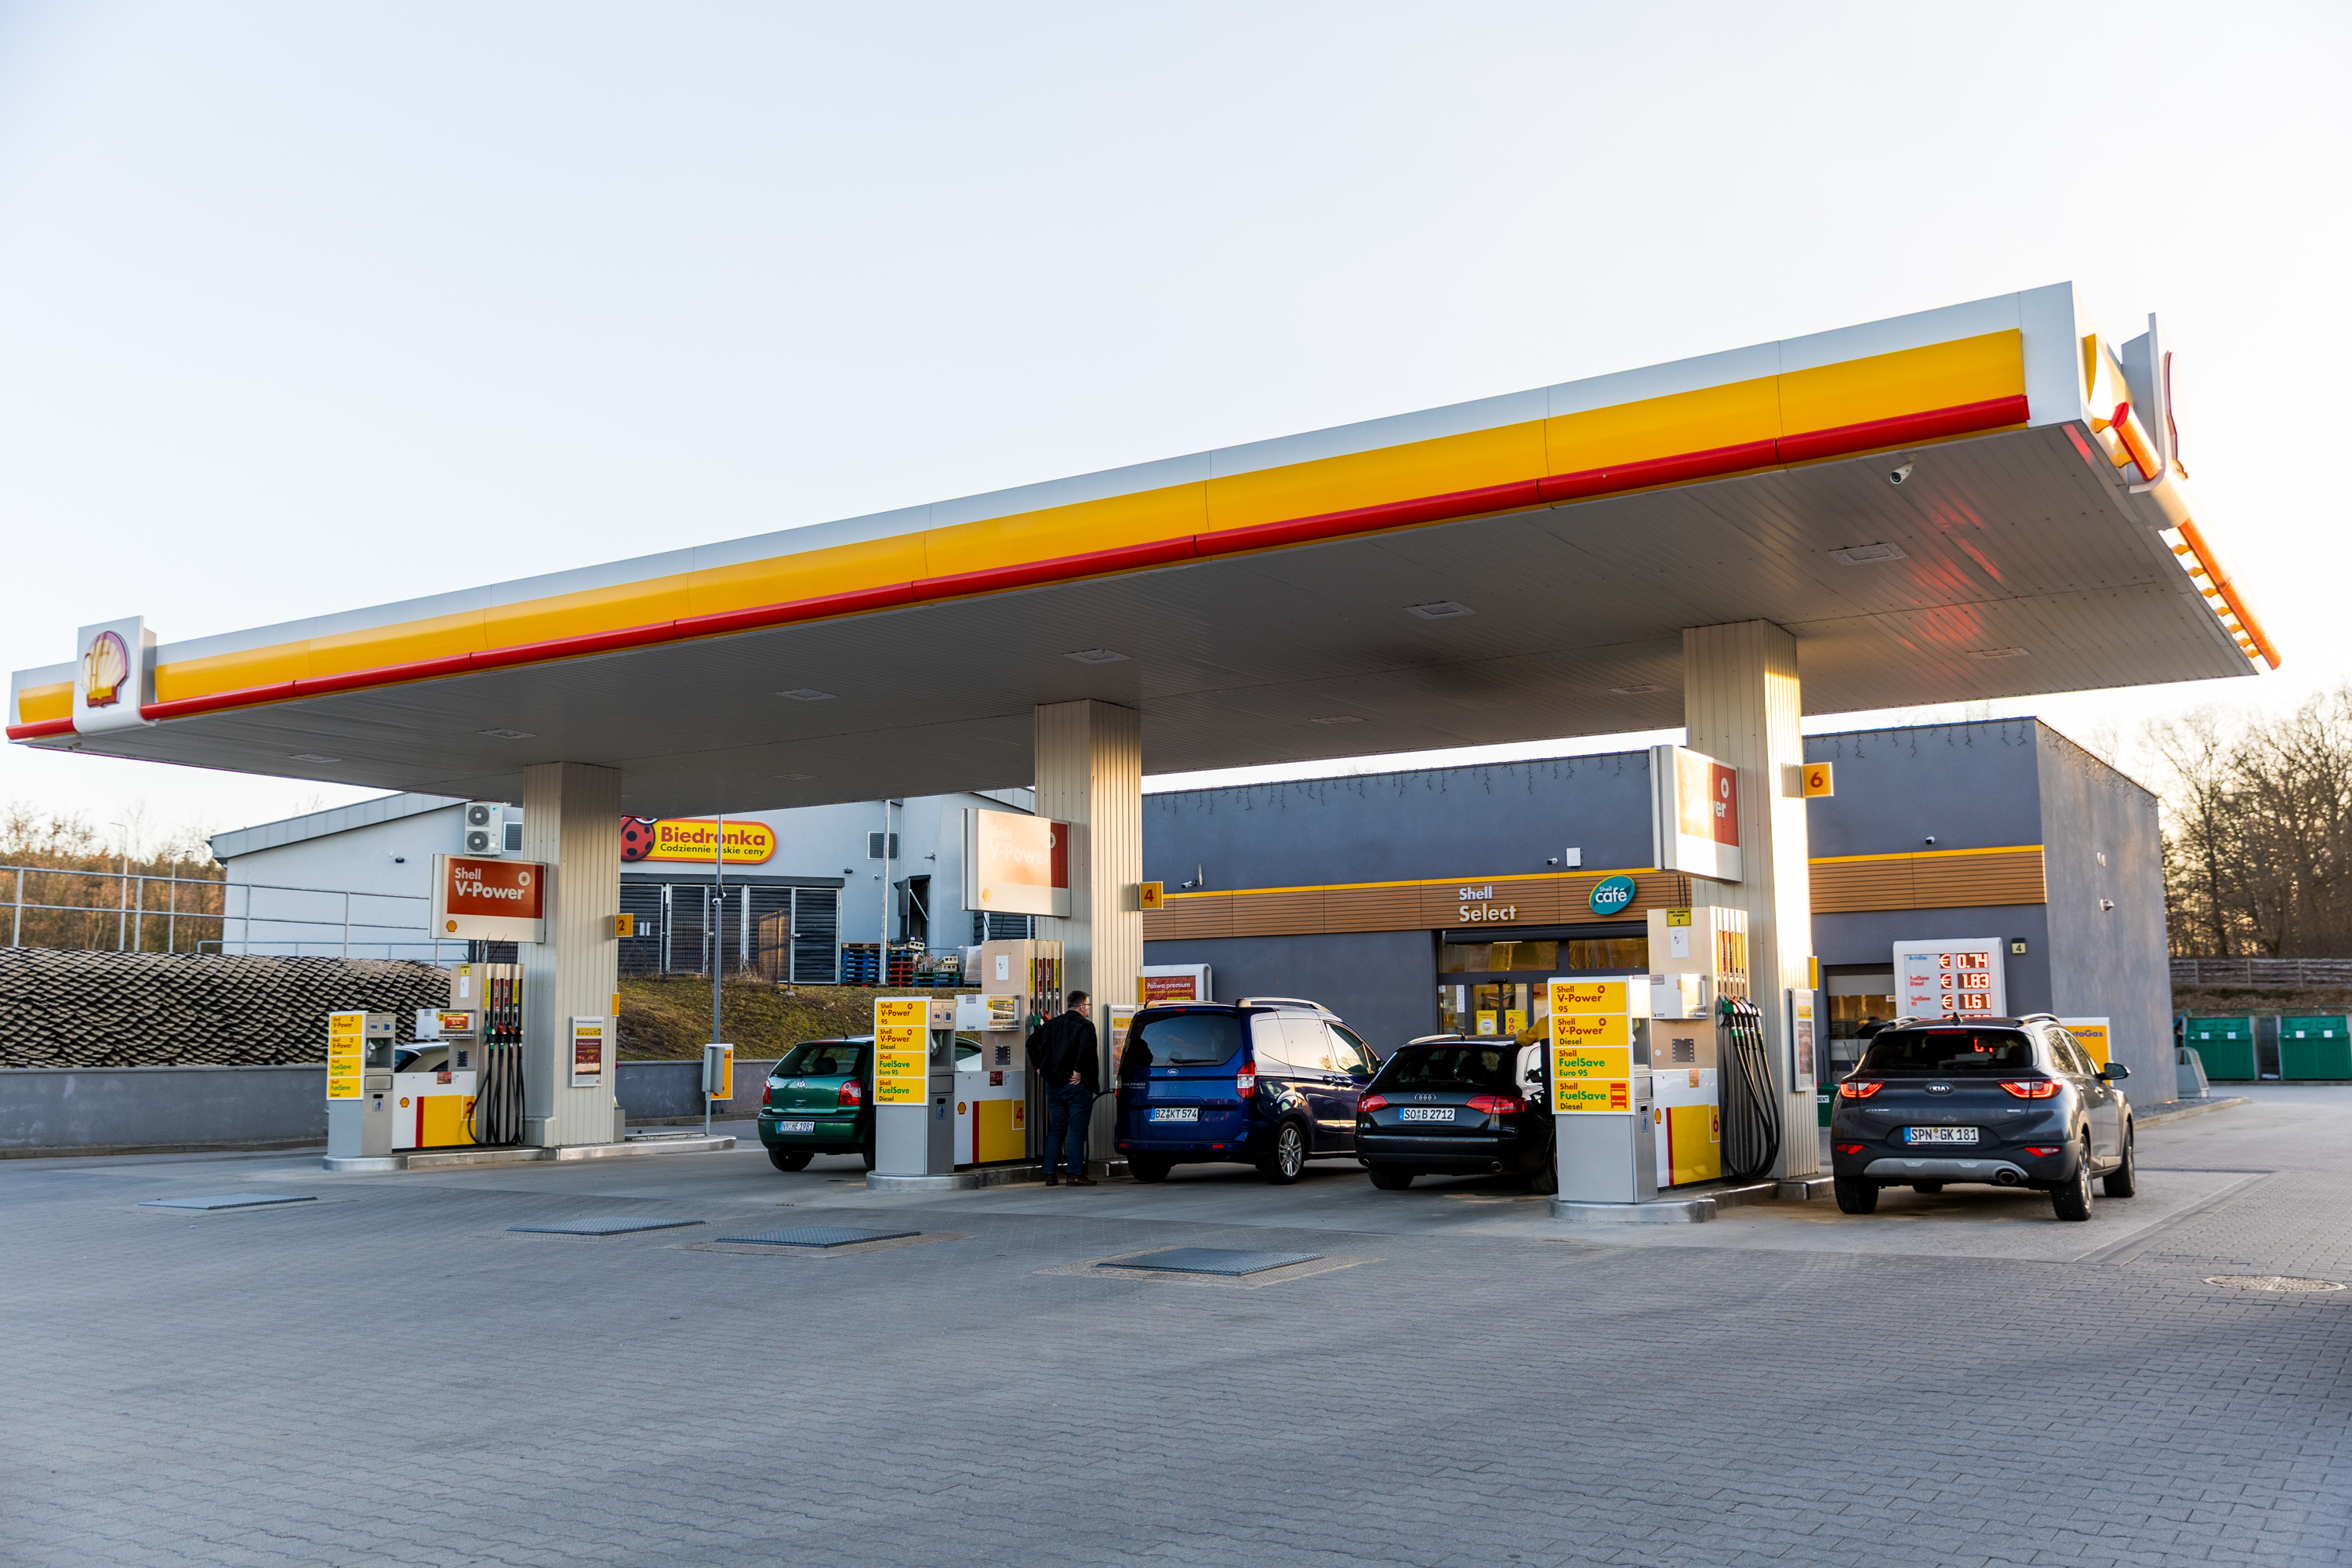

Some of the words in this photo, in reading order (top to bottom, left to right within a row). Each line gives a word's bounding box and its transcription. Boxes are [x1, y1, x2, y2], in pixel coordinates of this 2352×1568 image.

[1810, 771, 1823, 788] 6
[661, 826, 765, 846] Biedronka
[988, 825, 1011, 840] Shell
[660, 844, 711, 853] Codziennie
[714, 846, 741, 855] nskie
[989, 840, 1051, 865] V-Power
[455, 866, 481, 880] Shell
[455, 880, 524, 900] V-Power
[1144, 889, 1154, 902] 4
[1459, 886, 1493, 901] Shell
[1595, 887, 1628, 903] café
[1459, 903, 1516, 922] Select
[619, 920, 625, 931] 2
[1957, 953, 1989, 969] 0.74
[1962, 973, 1990, 989] 1.83
[1557, 994, 1602, 1003] V-Power
[1963, 993, 1991, 1009] 1.61
[1559, 1026, 1602, 1035] V-Power
[1559, 1058, 1605, 1067] FuelSave
[1560, 1091, 1606, 1100] FuelSave
[466, 1102, 474, 1113] 2
[1016, 1107, 1024, 1122] 4
[1155, 1109, 1166, 1118] BZ
[1171, 1109, 1181, 1118] KT
[1182, 1109, 1197, 1118] 574
[1404, 1109, 1416, 1120] SO
[1422, 1109, 1428, 1120] B
[1430, 1109, 1453, 1120] 2712
[1713, 1115, 1719, 1133] 6
[1911, 1129, 1932, 1141] SPN
[1940, 1129, 1954, 1141] GK
[1956, 1129, 1977, 1141] 181
